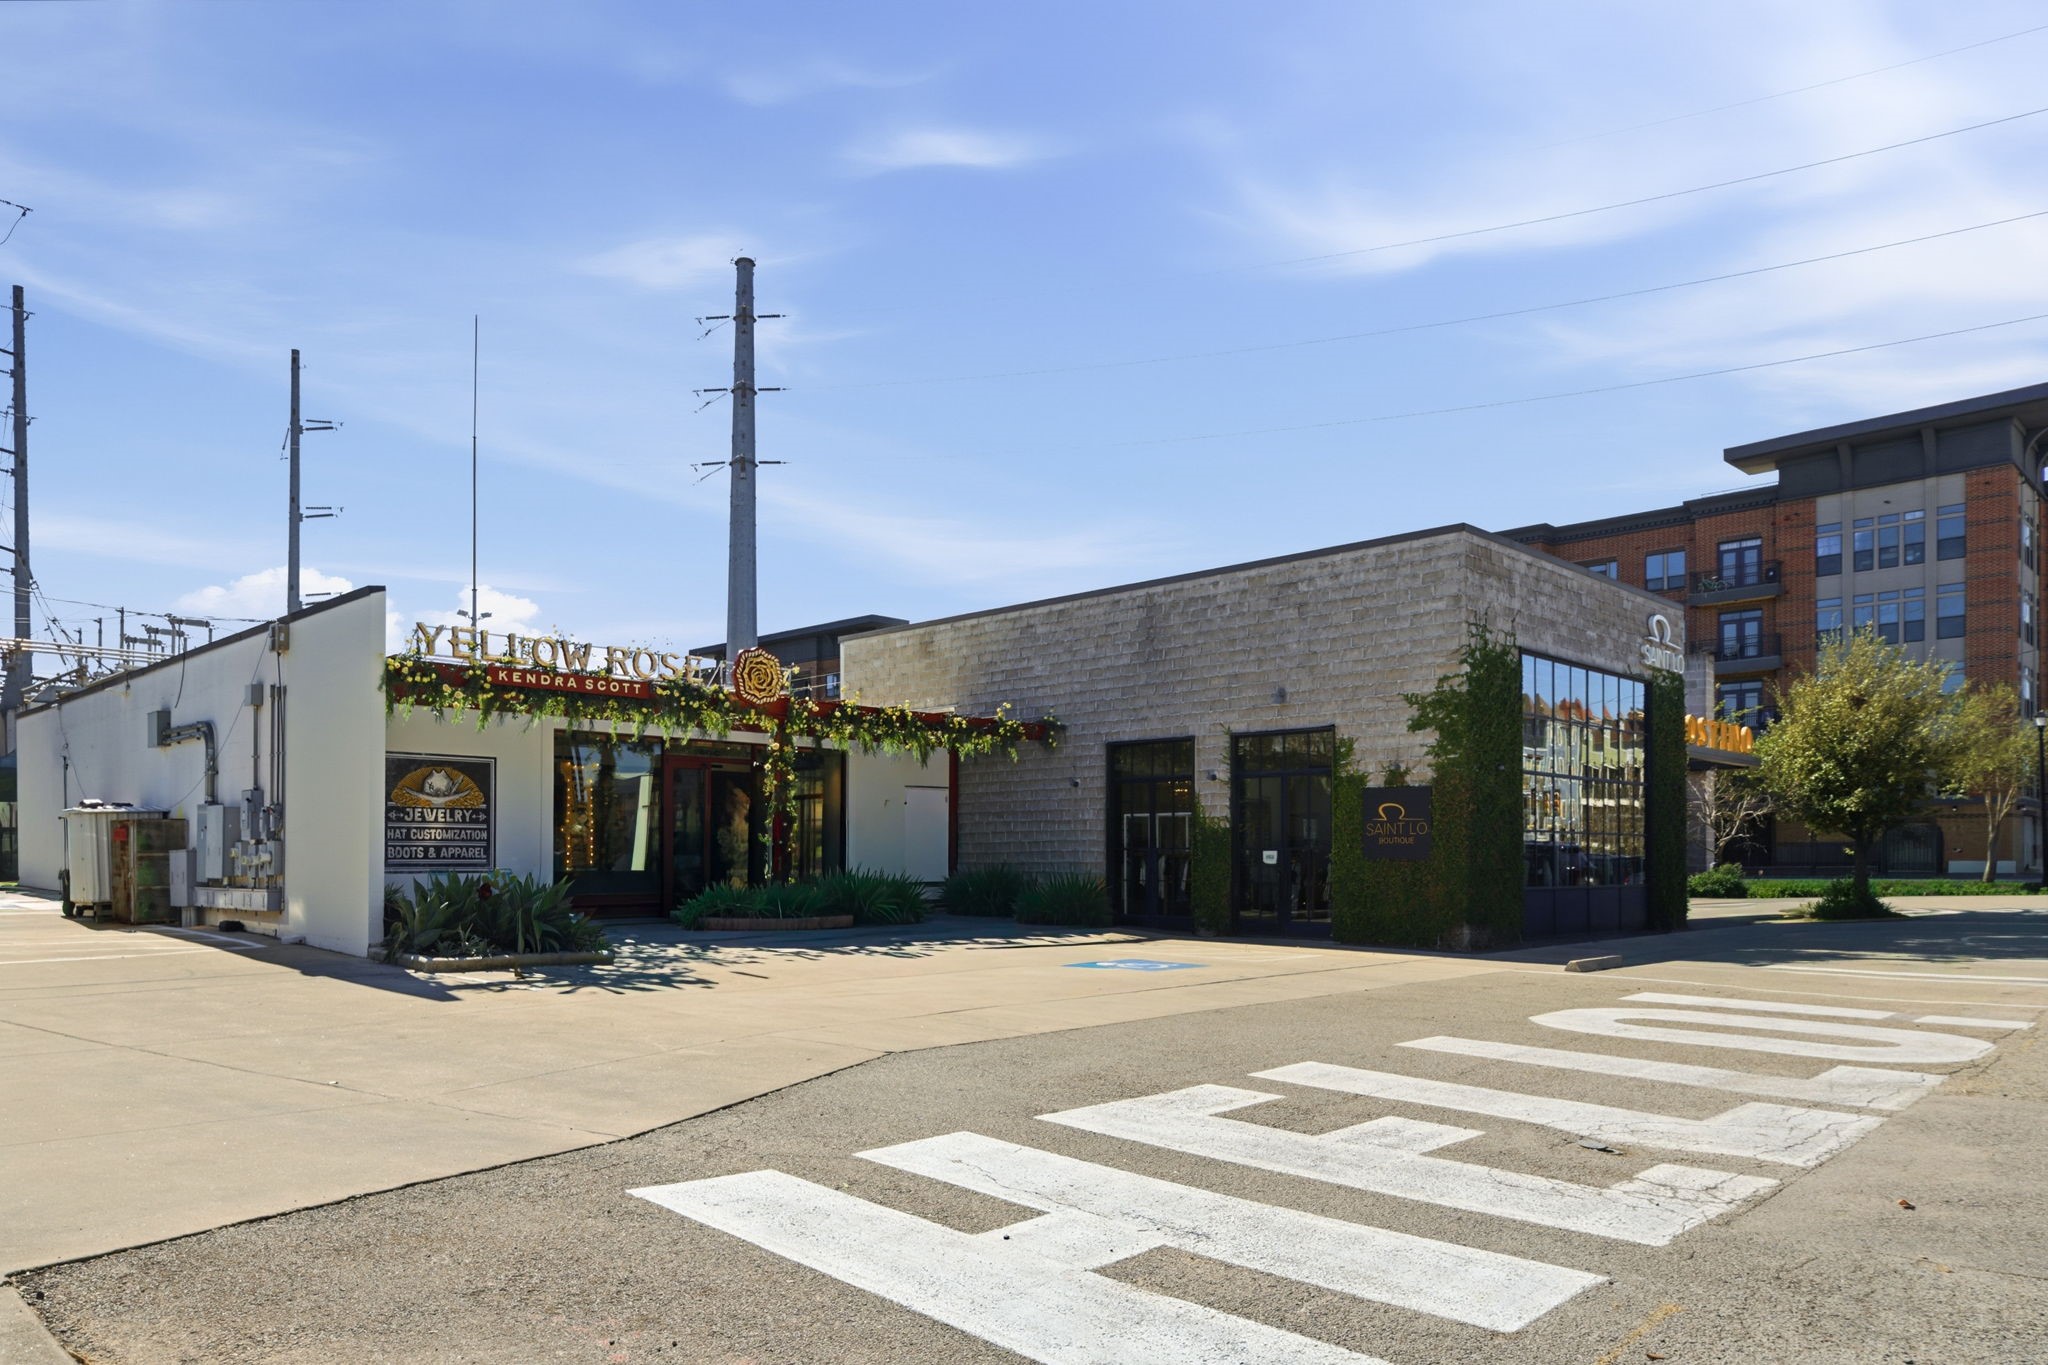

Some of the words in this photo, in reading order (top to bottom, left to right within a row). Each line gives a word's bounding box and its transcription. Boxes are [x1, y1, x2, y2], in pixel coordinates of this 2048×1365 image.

[415, 621, 592, 672] YELLOW
[605, 645, 705, 685] ROSE
[1640, 644, 1671, 670] SAINT
[1671, 652, 1685, 674] LO
[498, 670, 577, 689] KENDRA
[585, 678, 641, 695] SCOTT
[404, 808, 472, 822] JEWELRY
[387, 829, 407, 840] HAT
[410, 829, 488, 841] CUSTOMIZATION
[1366, 821, 1406, 837] SAINT
[1409, 821, 1428, 835] LO
[1379, 836, 1415, 845] BOUTIQUE
[387, 846, 425, 858] BOOTS
[427, 847, 437, 858] &
[440, 847, 487, 858] APPAREL
